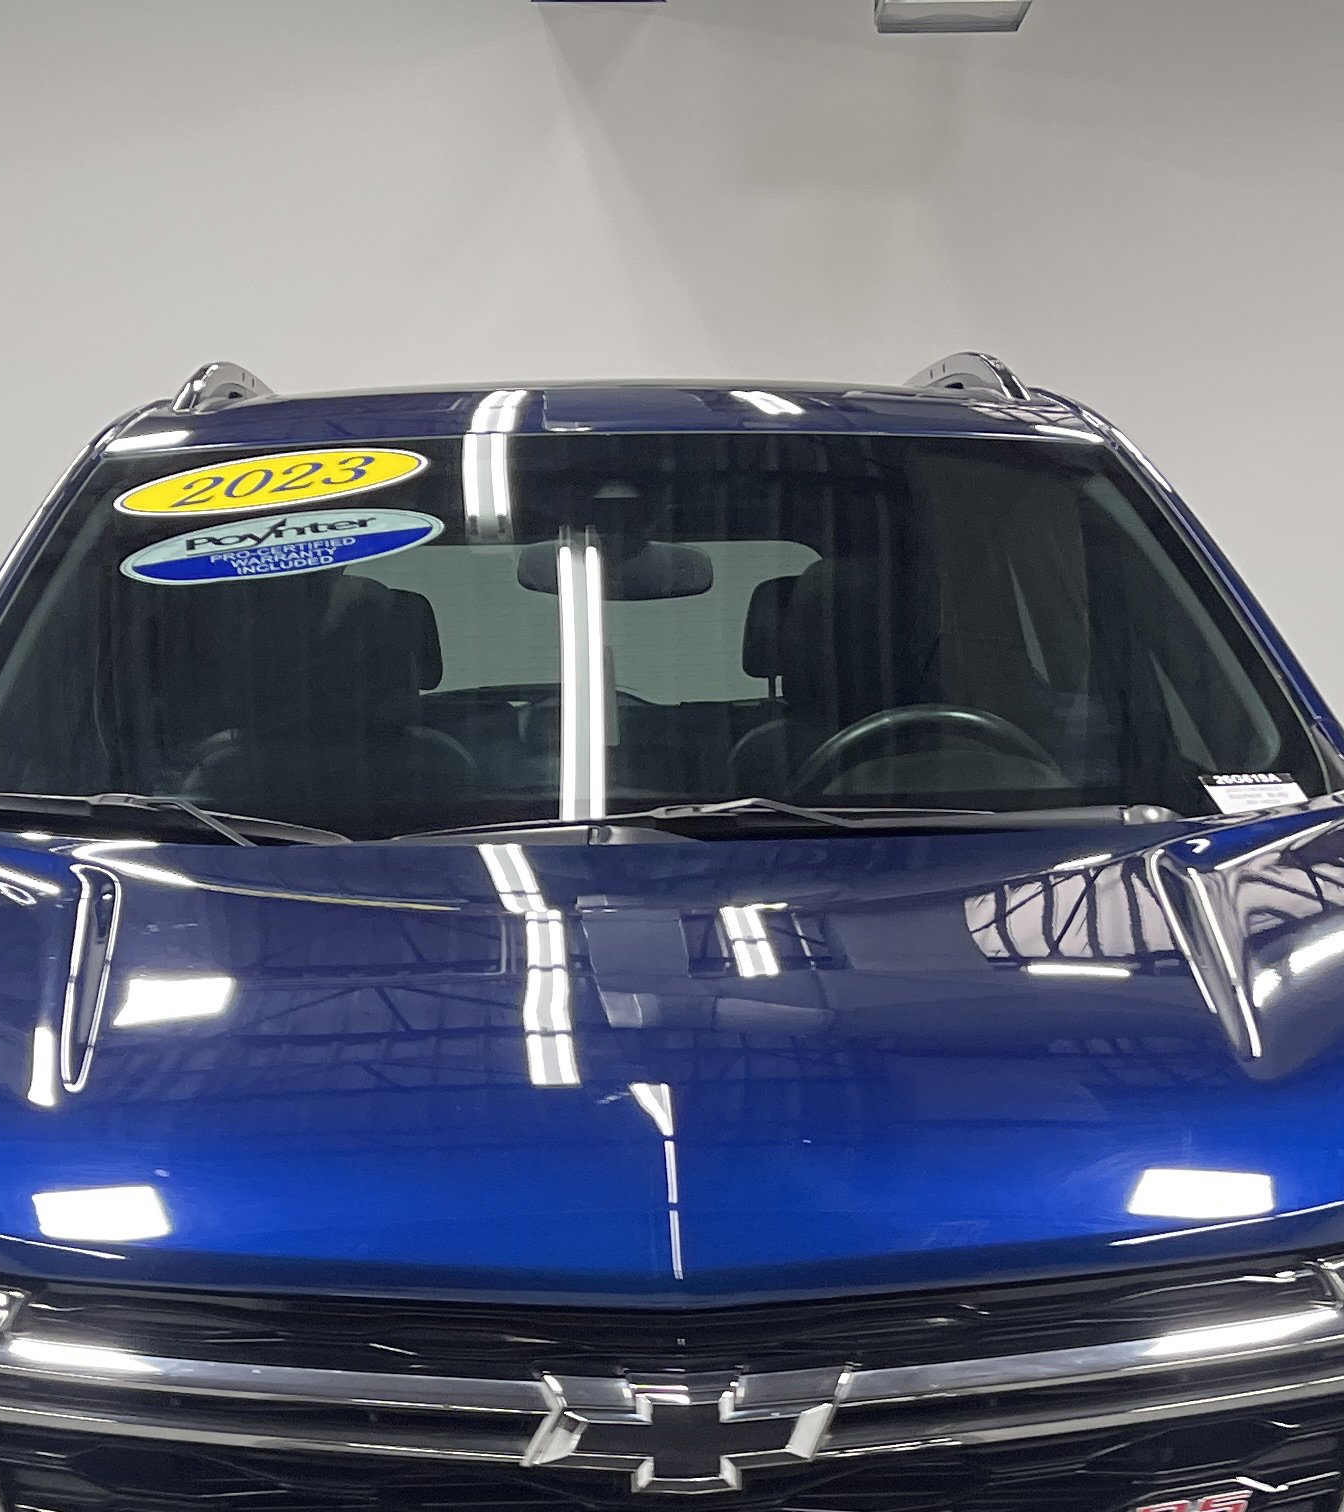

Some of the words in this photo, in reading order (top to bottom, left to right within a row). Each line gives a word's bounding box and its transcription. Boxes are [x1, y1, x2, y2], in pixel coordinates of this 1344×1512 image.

[169, 456, 376, 508] 2023
[184, 515, 378, 552] Poynter
[209, 536, 357, 564] PRO-CERTIFIED
[230, 547, 337, 569] WARRANTY
[236, 555, 335, 576] INCLUDED
